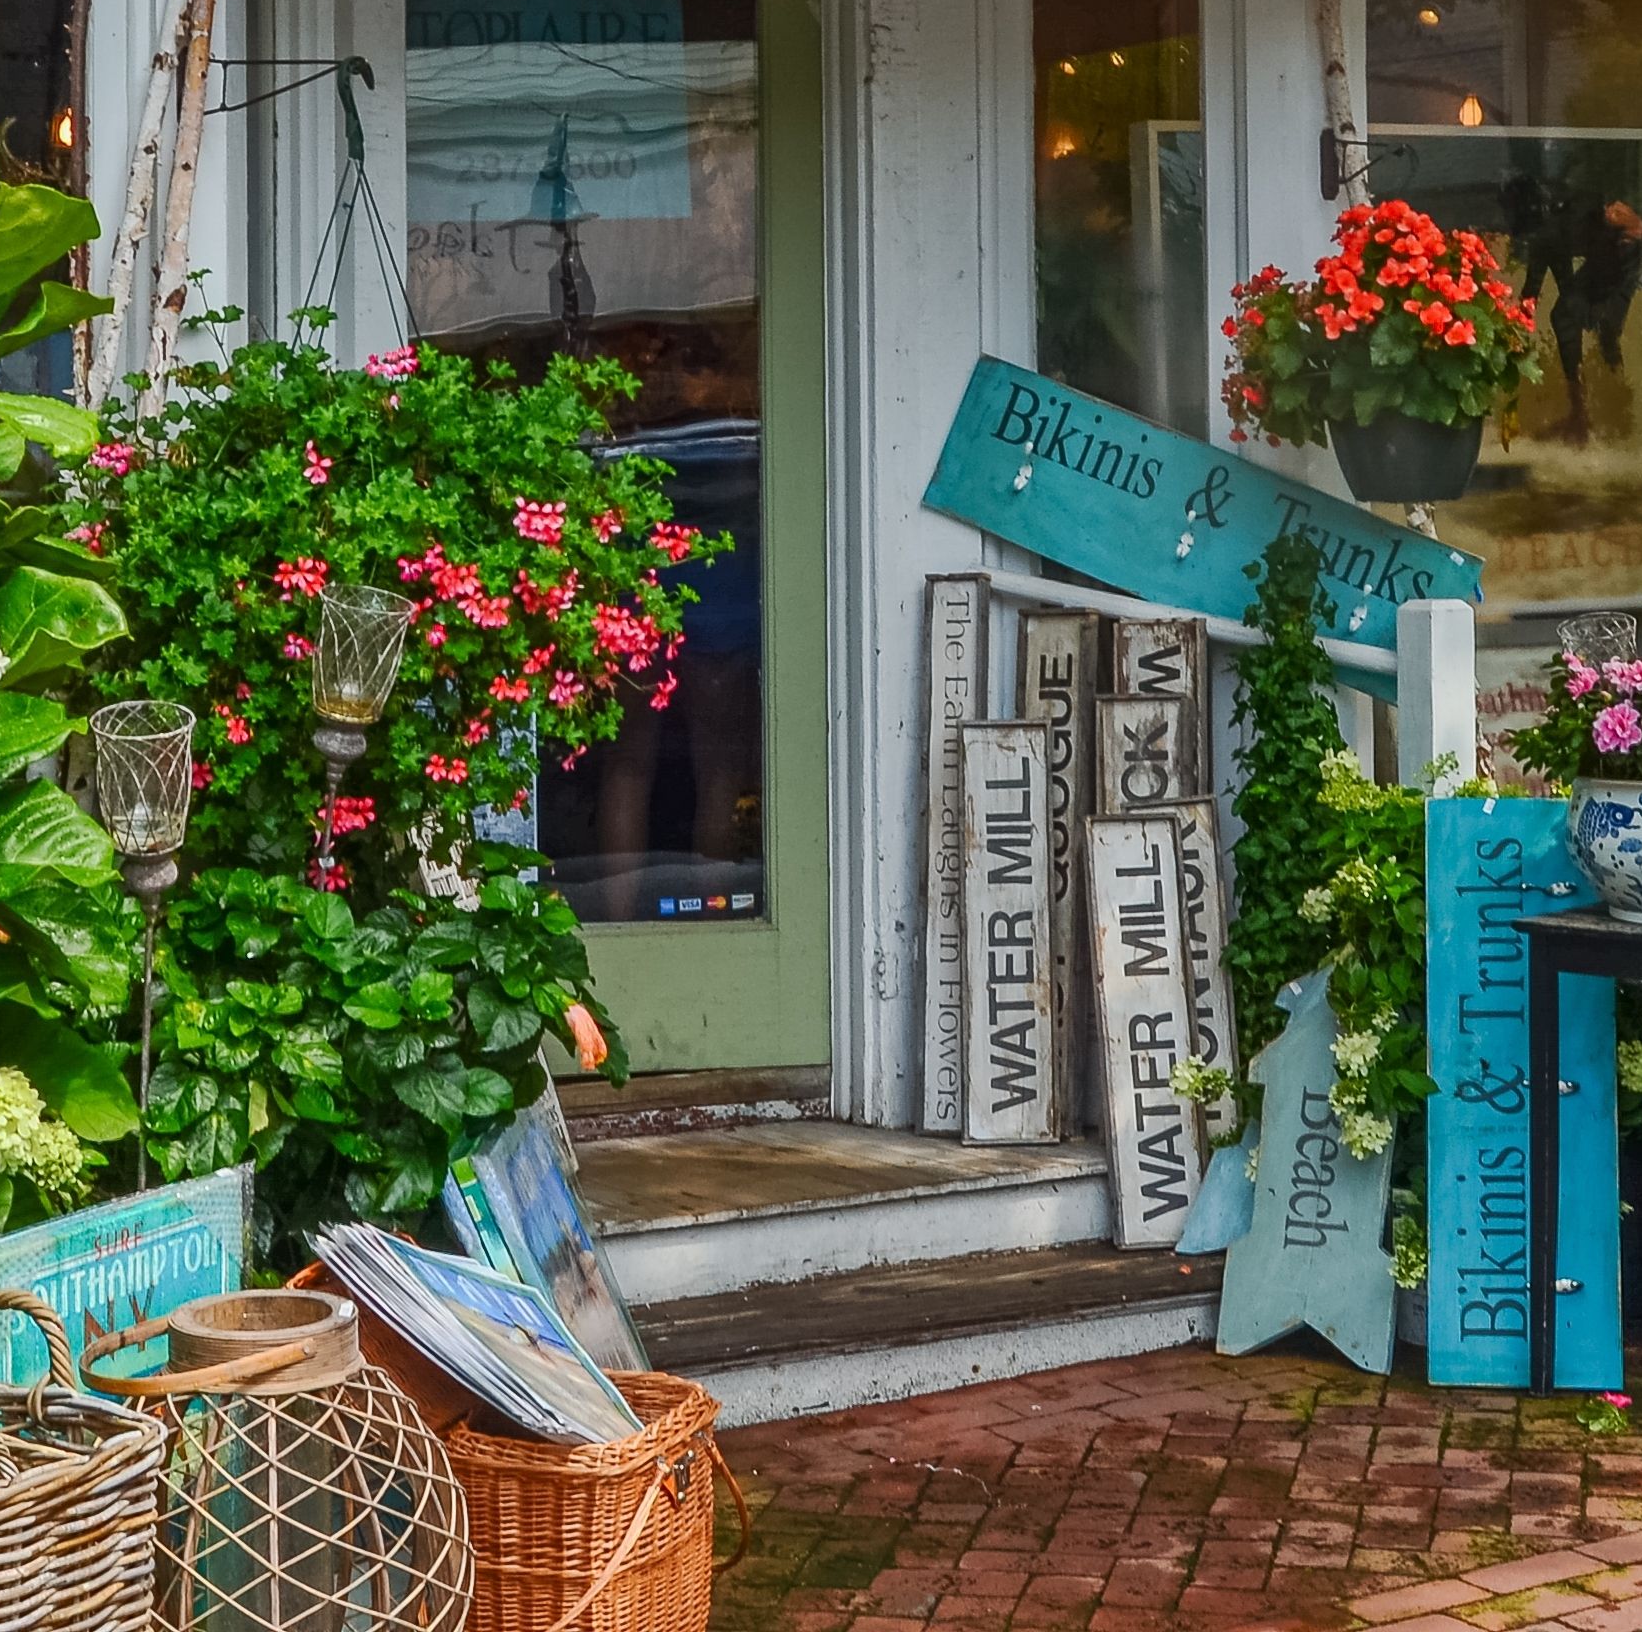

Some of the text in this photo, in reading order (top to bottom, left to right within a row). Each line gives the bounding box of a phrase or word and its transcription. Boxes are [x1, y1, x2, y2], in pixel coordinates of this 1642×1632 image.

[990, 381, 1435, 603] Bikinis & Trunks
[945, 590, 971, 660] The
[984, 755, 1039, 1114] WATER MILL
[1114, 842, 1171, 977] MILL
[1457, 835, 1527, 1038] Trunks
[1129, 1011, 1190, 1223] WATER
[1282, 1084, 1349, 1250] Beach
[1456, 1058, 1527, 1116] &
[93, 1220, 145, 1262] SURF
[1457, 1145, 1527, 1343] Bikinis
